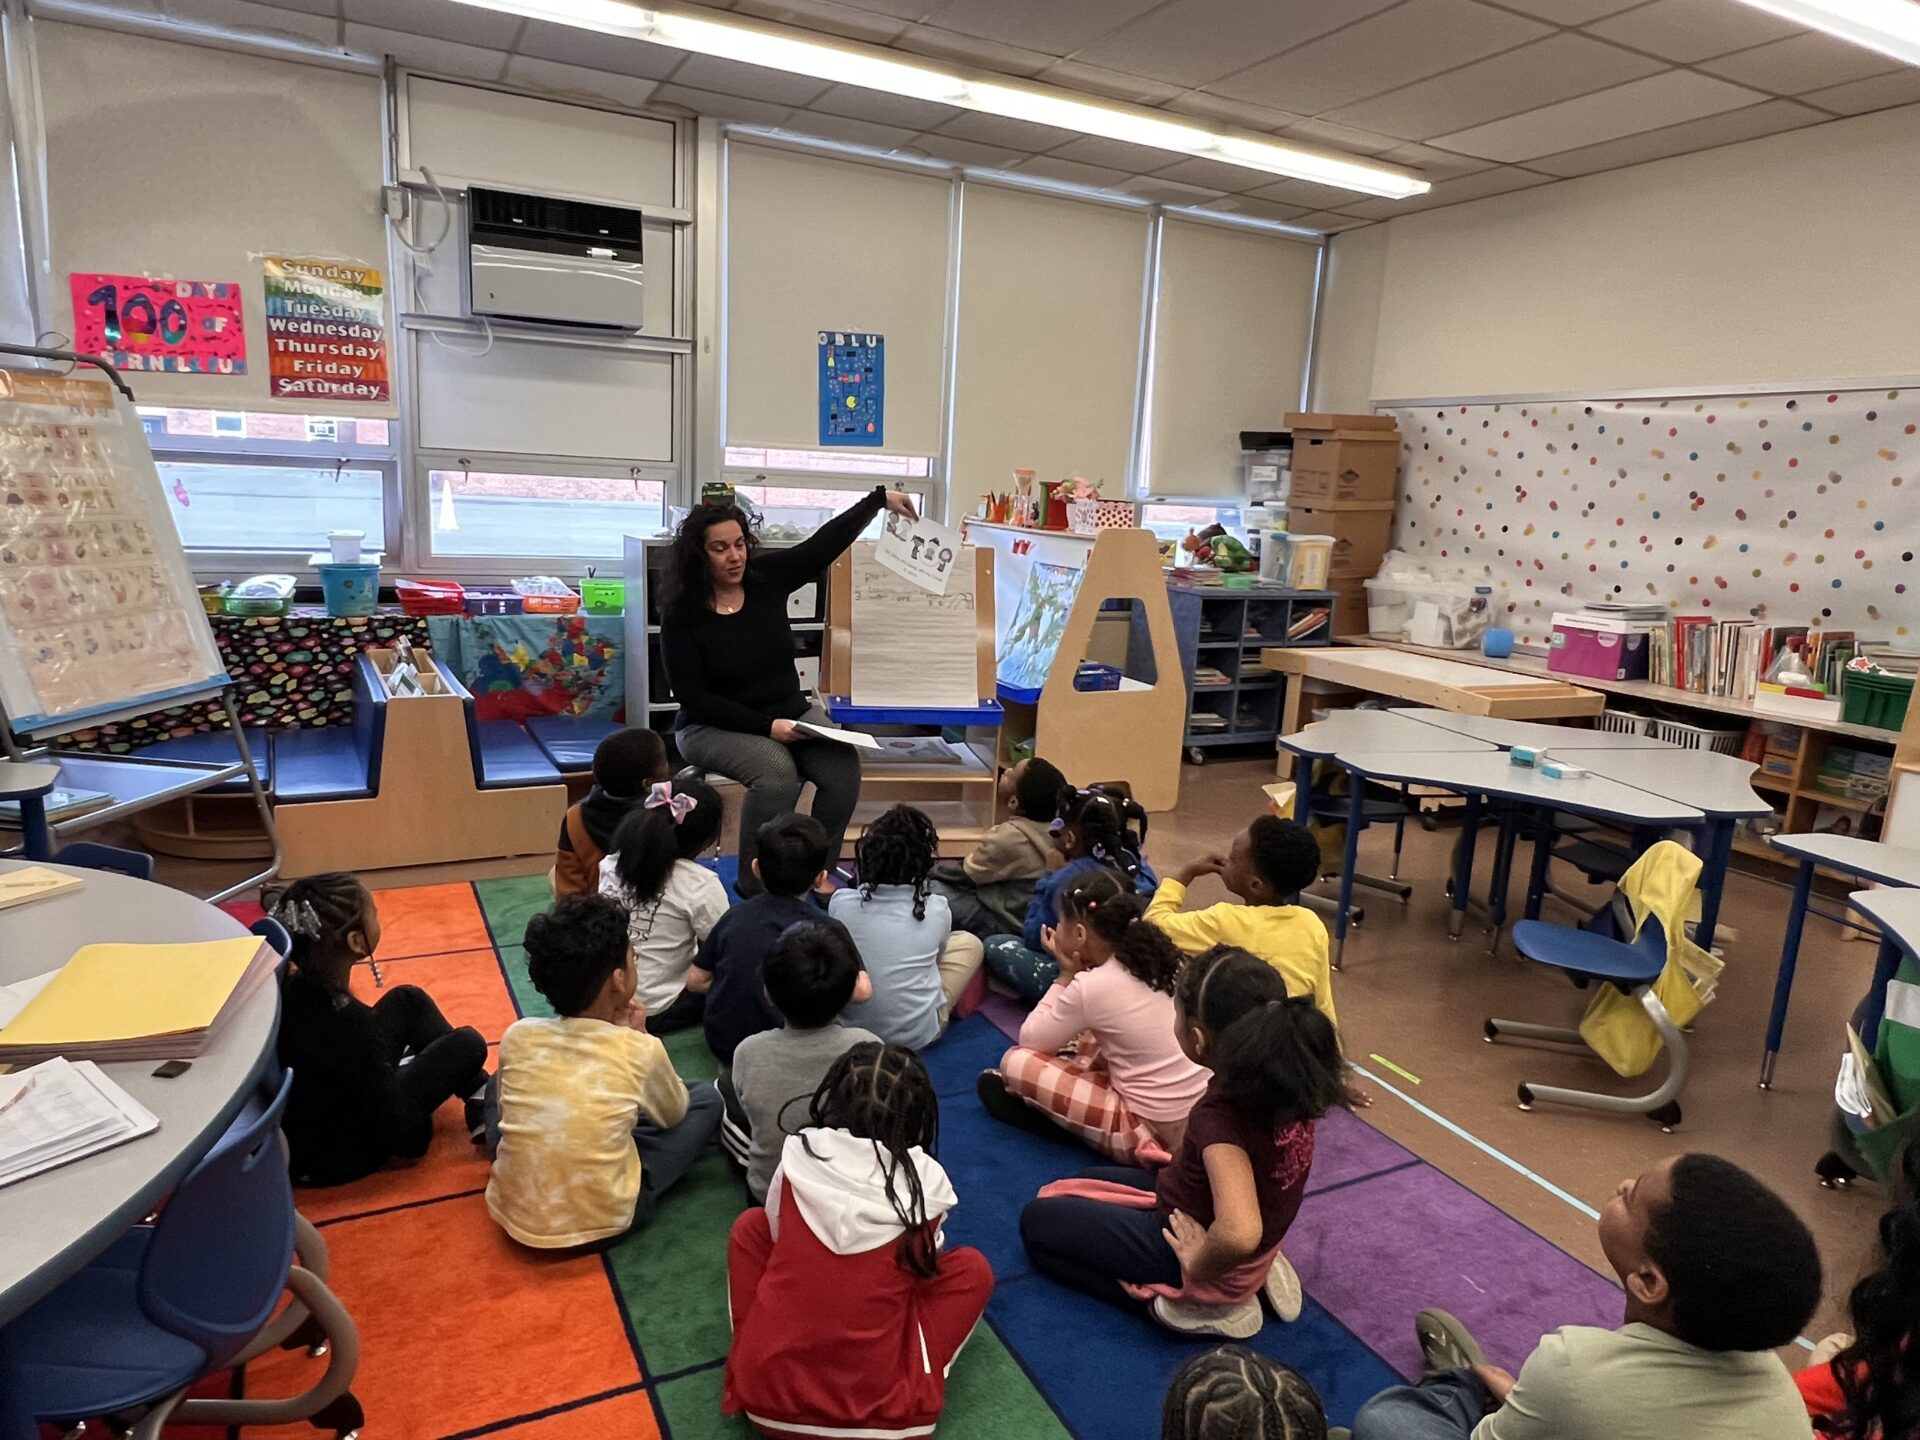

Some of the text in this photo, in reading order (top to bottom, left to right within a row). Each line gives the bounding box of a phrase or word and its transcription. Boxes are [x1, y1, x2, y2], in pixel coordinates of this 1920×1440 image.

[281, 260, 364, 283] Sunday
[176, 281, 228, 299] DAYS
[87, 284, 188, 346] 100
[284, 299, 365, 322] Tuesday
[201, 316, 228, 333] OF
[269, 318, 382, 342] Wednesday
[275, 338, 380, 360] Thursday
[293, 360, 364, 378] Friday
[279, 378, 380, 399] Saturday
